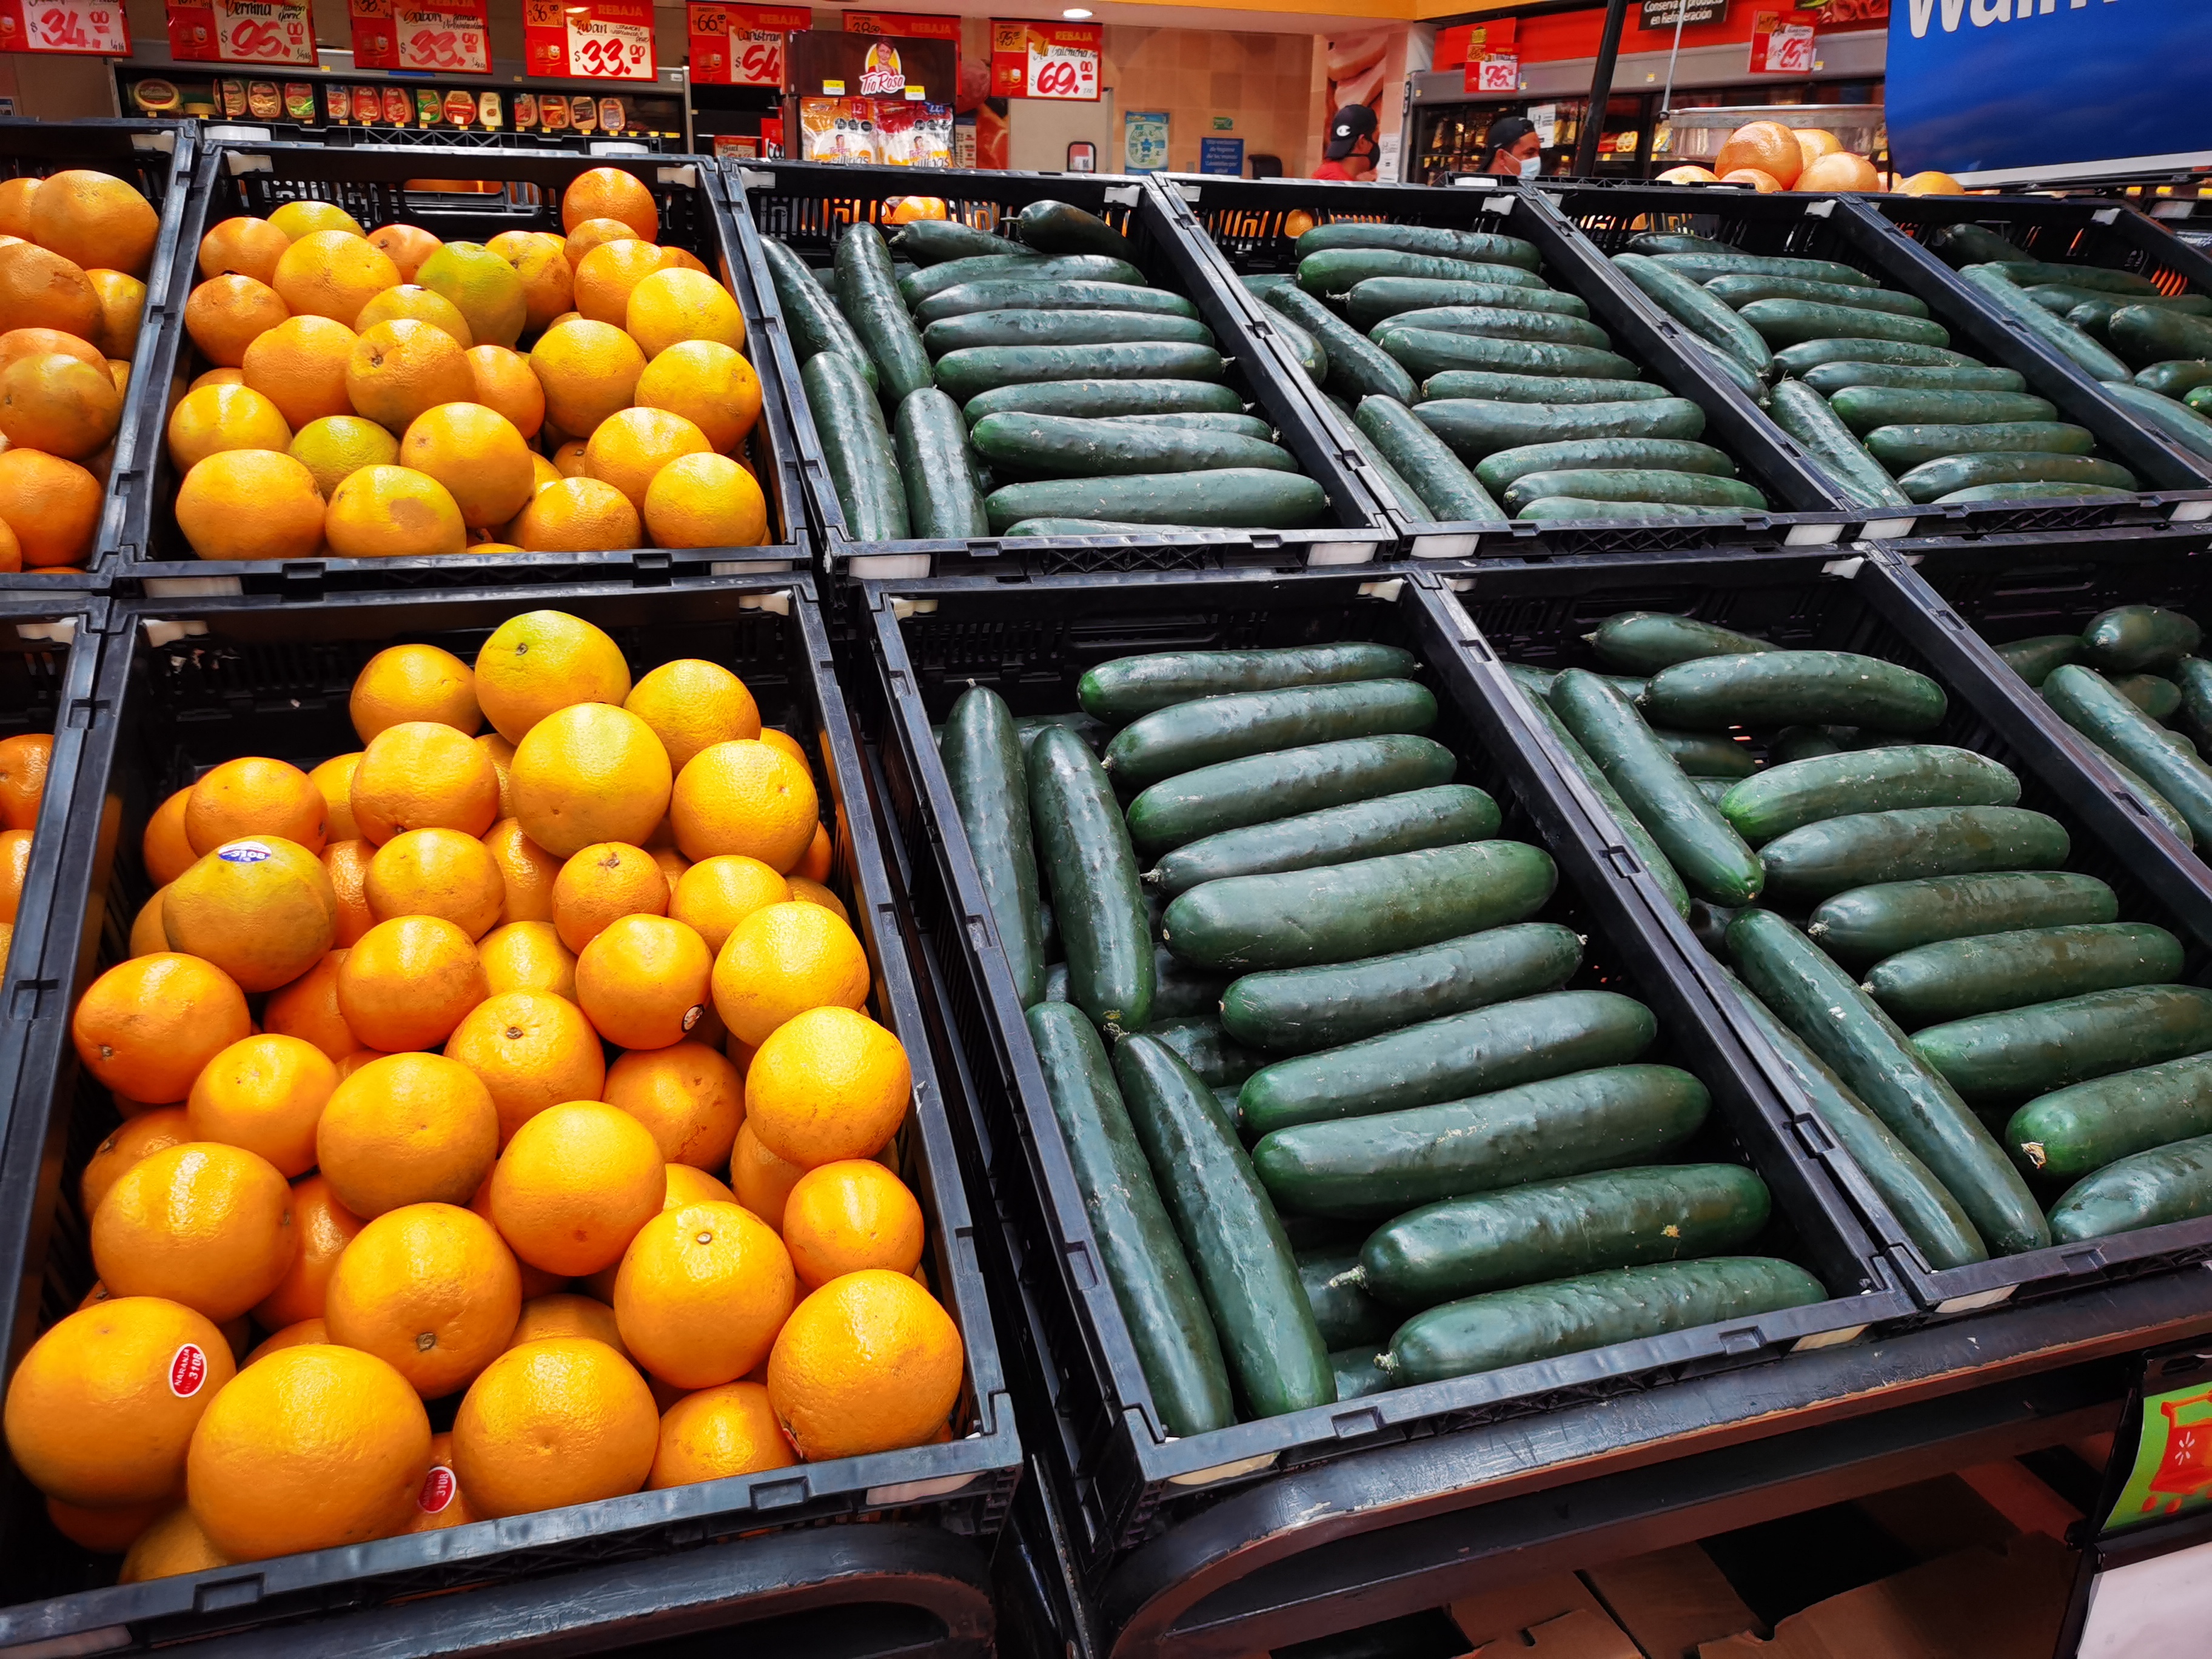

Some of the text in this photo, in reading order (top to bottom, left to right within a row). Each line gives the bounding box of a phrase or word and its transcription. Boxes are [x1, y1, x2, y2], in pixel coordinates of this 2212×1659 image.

[598, 4, 643, 17] REBAJA
[1661, 7, 1712, 24] Refrieración
[759, 14, 801, 25] REBAJA
[1056, 32, 1093, 41] REBAJA
[174, 1349, 190, 1386] NARANJA
[189, 1353, 202, 1380] 3108
[437, 1473, 449, 1496] 3108
